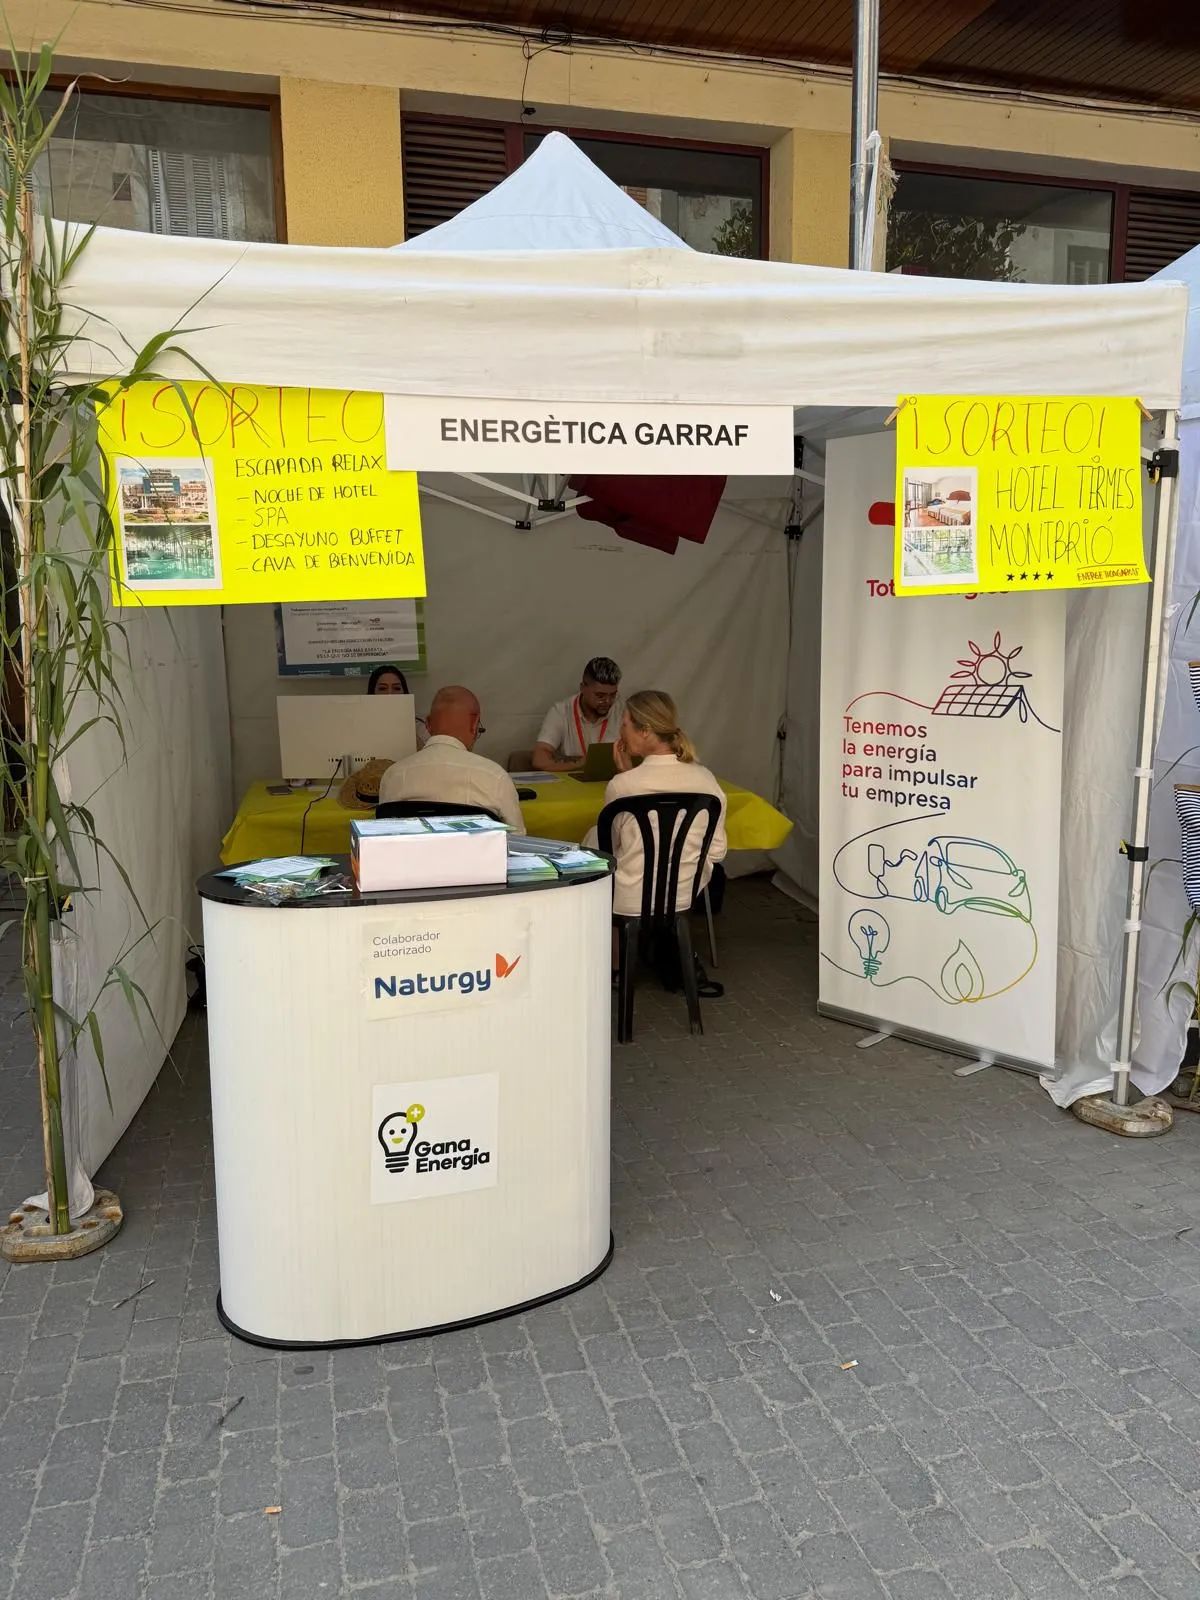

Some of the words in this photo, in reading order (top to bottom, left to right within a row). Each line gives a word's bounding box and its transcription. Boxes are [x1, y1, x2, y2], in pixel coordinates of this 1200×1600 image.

[440, 414, 627, 445] ENERGÈTICA
[634, 422, 749, 447] GARRAF
[235, 456, 323, 478] ESCAPADA
[332, 453, 384, 473] RELAX
[308, 486, 325, 502] DE
[334, 483, 378, 499] HOTEL
[996, 464, 1065, 513] HOTEL
[252, 507, 289, 528] SPA
[251, 530, 339, 550] DESAYUNO
[350, 528, 404, 546] BUFFET
[251, 555, 296, 573] CAVA
[305, 554, 322, 569] DE
[843, 716, 928, 738] Tenemos
[843, 738, 857, 755] la
[863, 744, 937, 764] energía
[842, 763, 882, 779] para
[888, 765, 978, 789] impulsar
[841, 782, 859, 798] tu
[866, 787, 951, 810] empresa
[372, 931, 441, 946] Colaborador
[373, 944, 432, 959] autorizado
[374, 968, 491, 999] Naturgy
[415, 1138, 471, 1157] Gana
